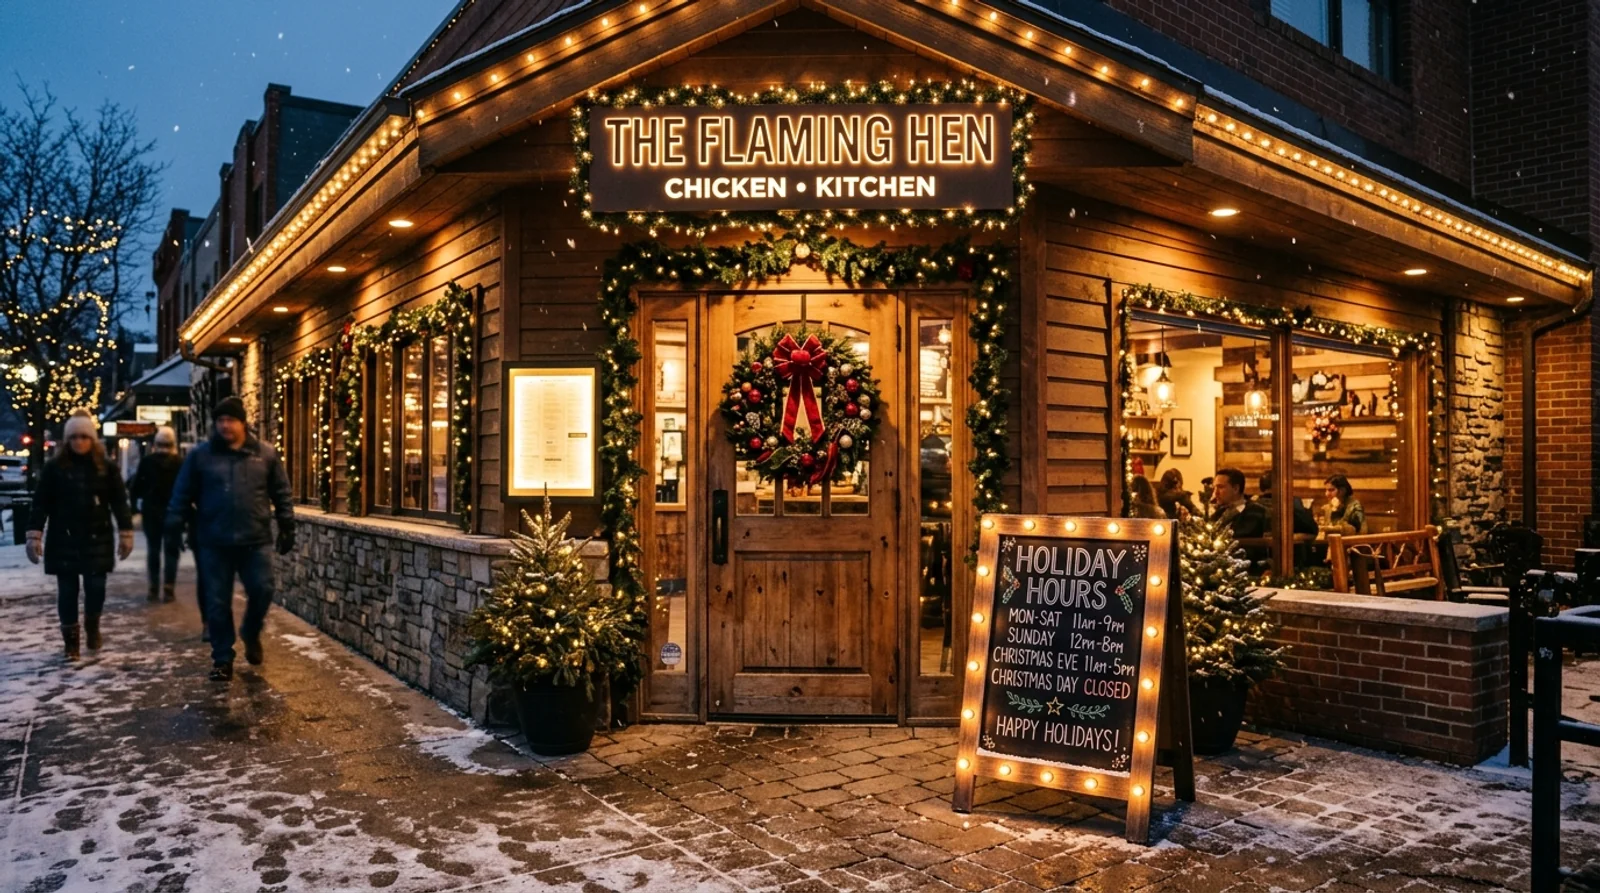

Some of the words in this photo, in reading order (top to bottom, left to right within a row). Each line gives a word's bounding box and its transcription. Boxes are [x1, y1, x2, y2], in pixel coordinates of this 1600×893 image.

[605, 116, 685, 166] THE
[697, 115, 892, 165] FLAMING
[906, 113, 995, 165] HEN
[664, 177, 787, 199] CHICKEN
[816, 176, 936, 198] KITCHEN
[1015, 545, 1127, 579] HOLIDAY
[1026, 576, 1107, 610] HOURS
[1008, 608, 1062, 628] MON-SAT
[1007, 627, 1056, 647] SUNDAY
[1057, 652, 1079, 671] EVE
[991, 668, 1053, 691] CHRISTMAS
[1056, 675, 1079, 694] DAY
[1083, 678, 1131, 699] CLOSED
[996, 715, 1039, 740] HAPPY
[1044, 721, 1119, 753] HOLIDAYS!
